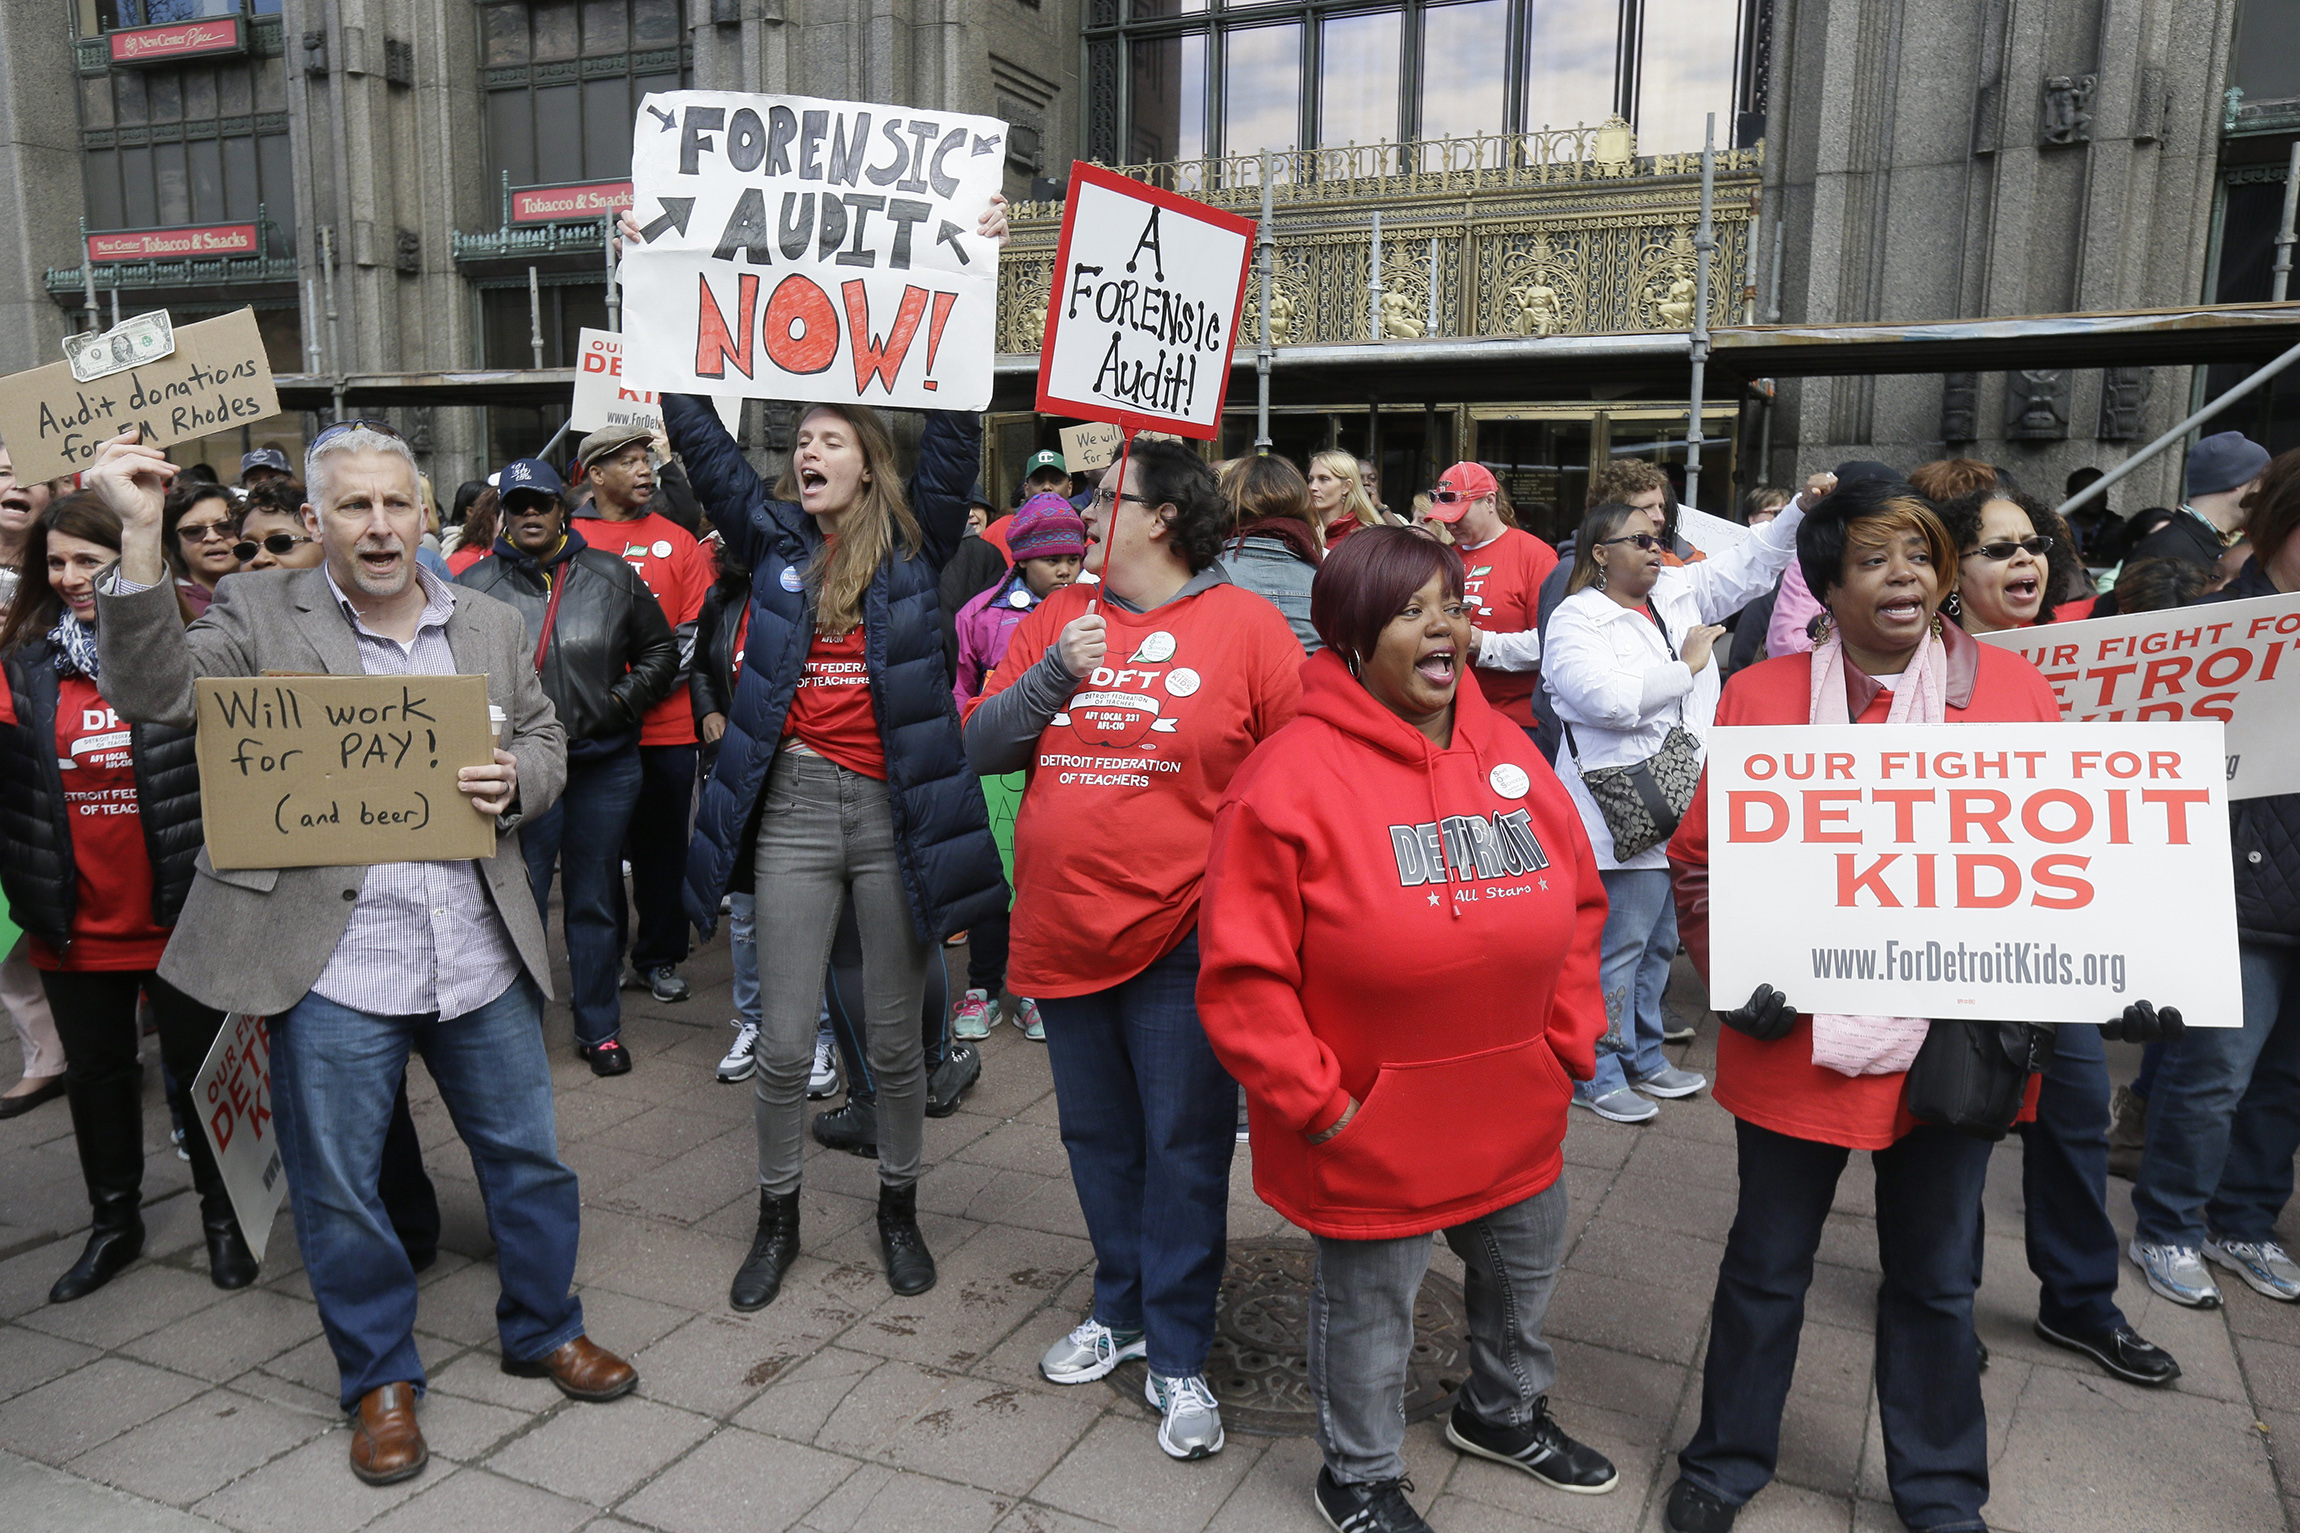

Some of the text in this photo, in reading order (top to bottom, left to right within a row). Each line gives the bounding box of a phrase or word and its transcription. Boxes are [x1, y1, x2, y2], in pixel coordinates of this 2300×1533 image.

[677, 105, 969, 200] FORENSIC
[522, 190, 634, 214] Tobacco & Snacks
[141, 236, 190, 253] Tobacco
[192, 233, 202, 250] &
[203, 231, 248, 249] Snacks
[711, 187, 933, 270] AUDIT
[1126, 205, 1165, 283] A
[1068, 262, 1220, 352] FORENSIC
[592, 340, 622, 354] OU
[695, 272, 958, 396] NOW!
[1092, 331, 1197, 416] Audit!
[39, 360, 257, 439] Audit donations
[61, 433, 104, 463] for
[171, 394, 261, 435] Rhodes
[1076, 432, 1098, 448] We
[1101, 424, 1124, 443] will
[1082, 448, 1102, 465] for
[2096, 621, 2233, 661] FIGHT
[797, 676, 870, 688] OF TEACHERS
[1088, 666, 1161, 689] DFT
[2043, 637, 2300, 720] ETROI
[213, 686, 437, 729] Will work
[1112, 693, 1149, 703] FEDERATION
[1084, 711, 1140, 722] AFT LOCAL 231
[1096, 720, 1126, 731] AFL-CIO
[90, 751, 129, 763] AFT LOCAL
[231, 728, 439, 776] for PAY!
[1040, 754, 1182, 773] DETROIT FEDERATION
[1744, 751, 2183, 781] OUR FIGHT FOR
[1059, 772, 1149, 787] OF TEACHERS
[80, 803, 140, 816] OF TEAC
[1726, 787, 2211, 846] DETROIT
[1454, 884, 1533, 903] All Stars
[1834, 853, 2096, 911] KIDS
[1811, 940, 2127, 993] www.ForDetroitKids.org
[207, 1044, 237, 1105] OUR
